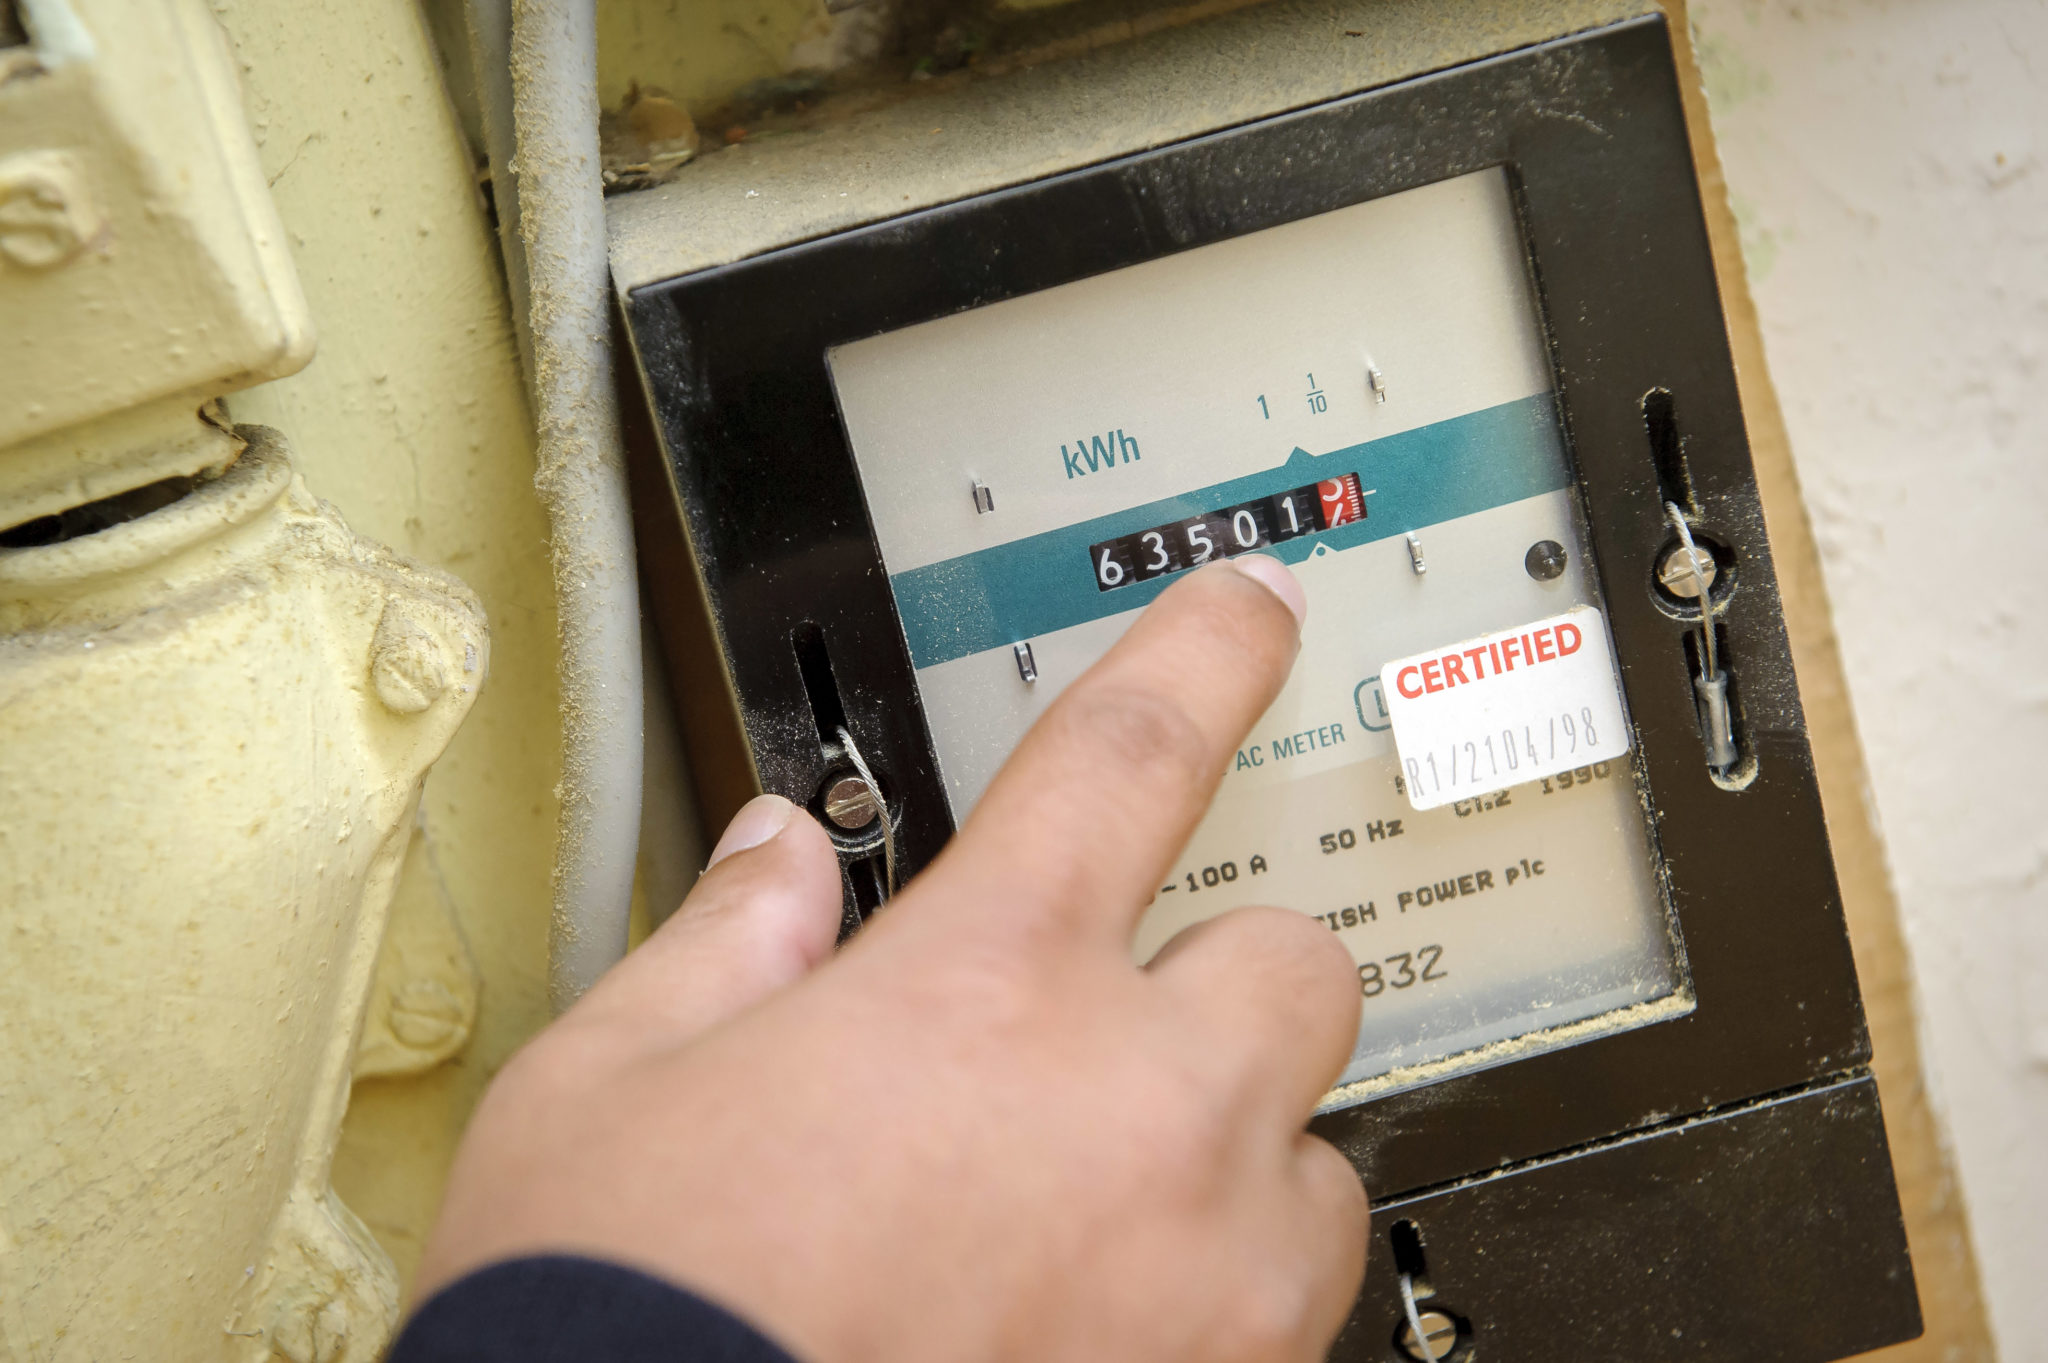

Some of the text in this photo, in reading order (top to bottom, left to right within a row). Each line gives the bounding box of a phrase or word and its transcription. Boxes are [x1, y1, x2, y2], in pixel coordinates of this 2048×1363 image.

[1060, 428, 1142, 480] kWh
[1396, 622, 1583, 700] CERTIFIED
[1236, 722, 1347, 772] AC METER
[1249, 853, 1268, 876] A
[1319, 828, 1357, 855] 50
[1366, 819, 1405, 843] Hz
[1539, 760, 1611, 796] 1990
[1396, 868, 1495, 914] POWER
[1504, 858, 1546, 887] plc
